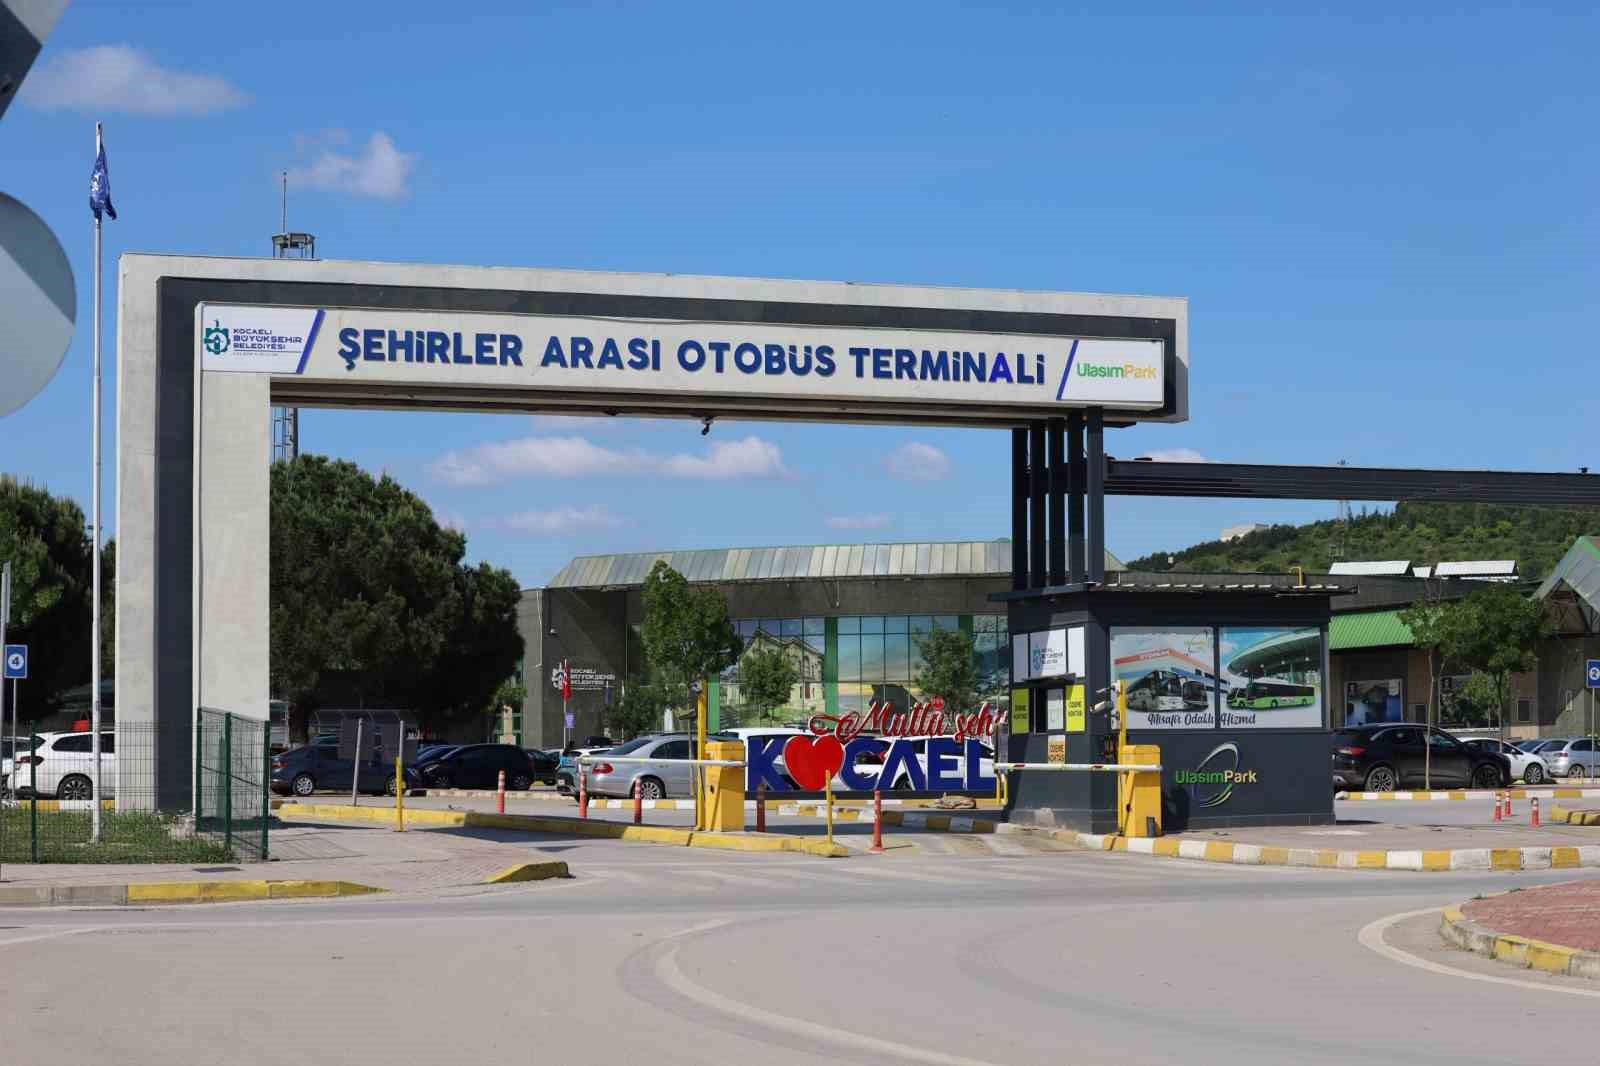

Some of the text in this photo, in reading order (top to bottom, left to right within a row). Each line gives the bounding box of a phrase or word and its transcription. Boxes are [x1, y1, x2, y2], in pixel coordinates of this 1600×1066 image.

[338, 327, 1045, 385] ŞEHİRLER ARASI OTOBÜS TERMİNALİ
